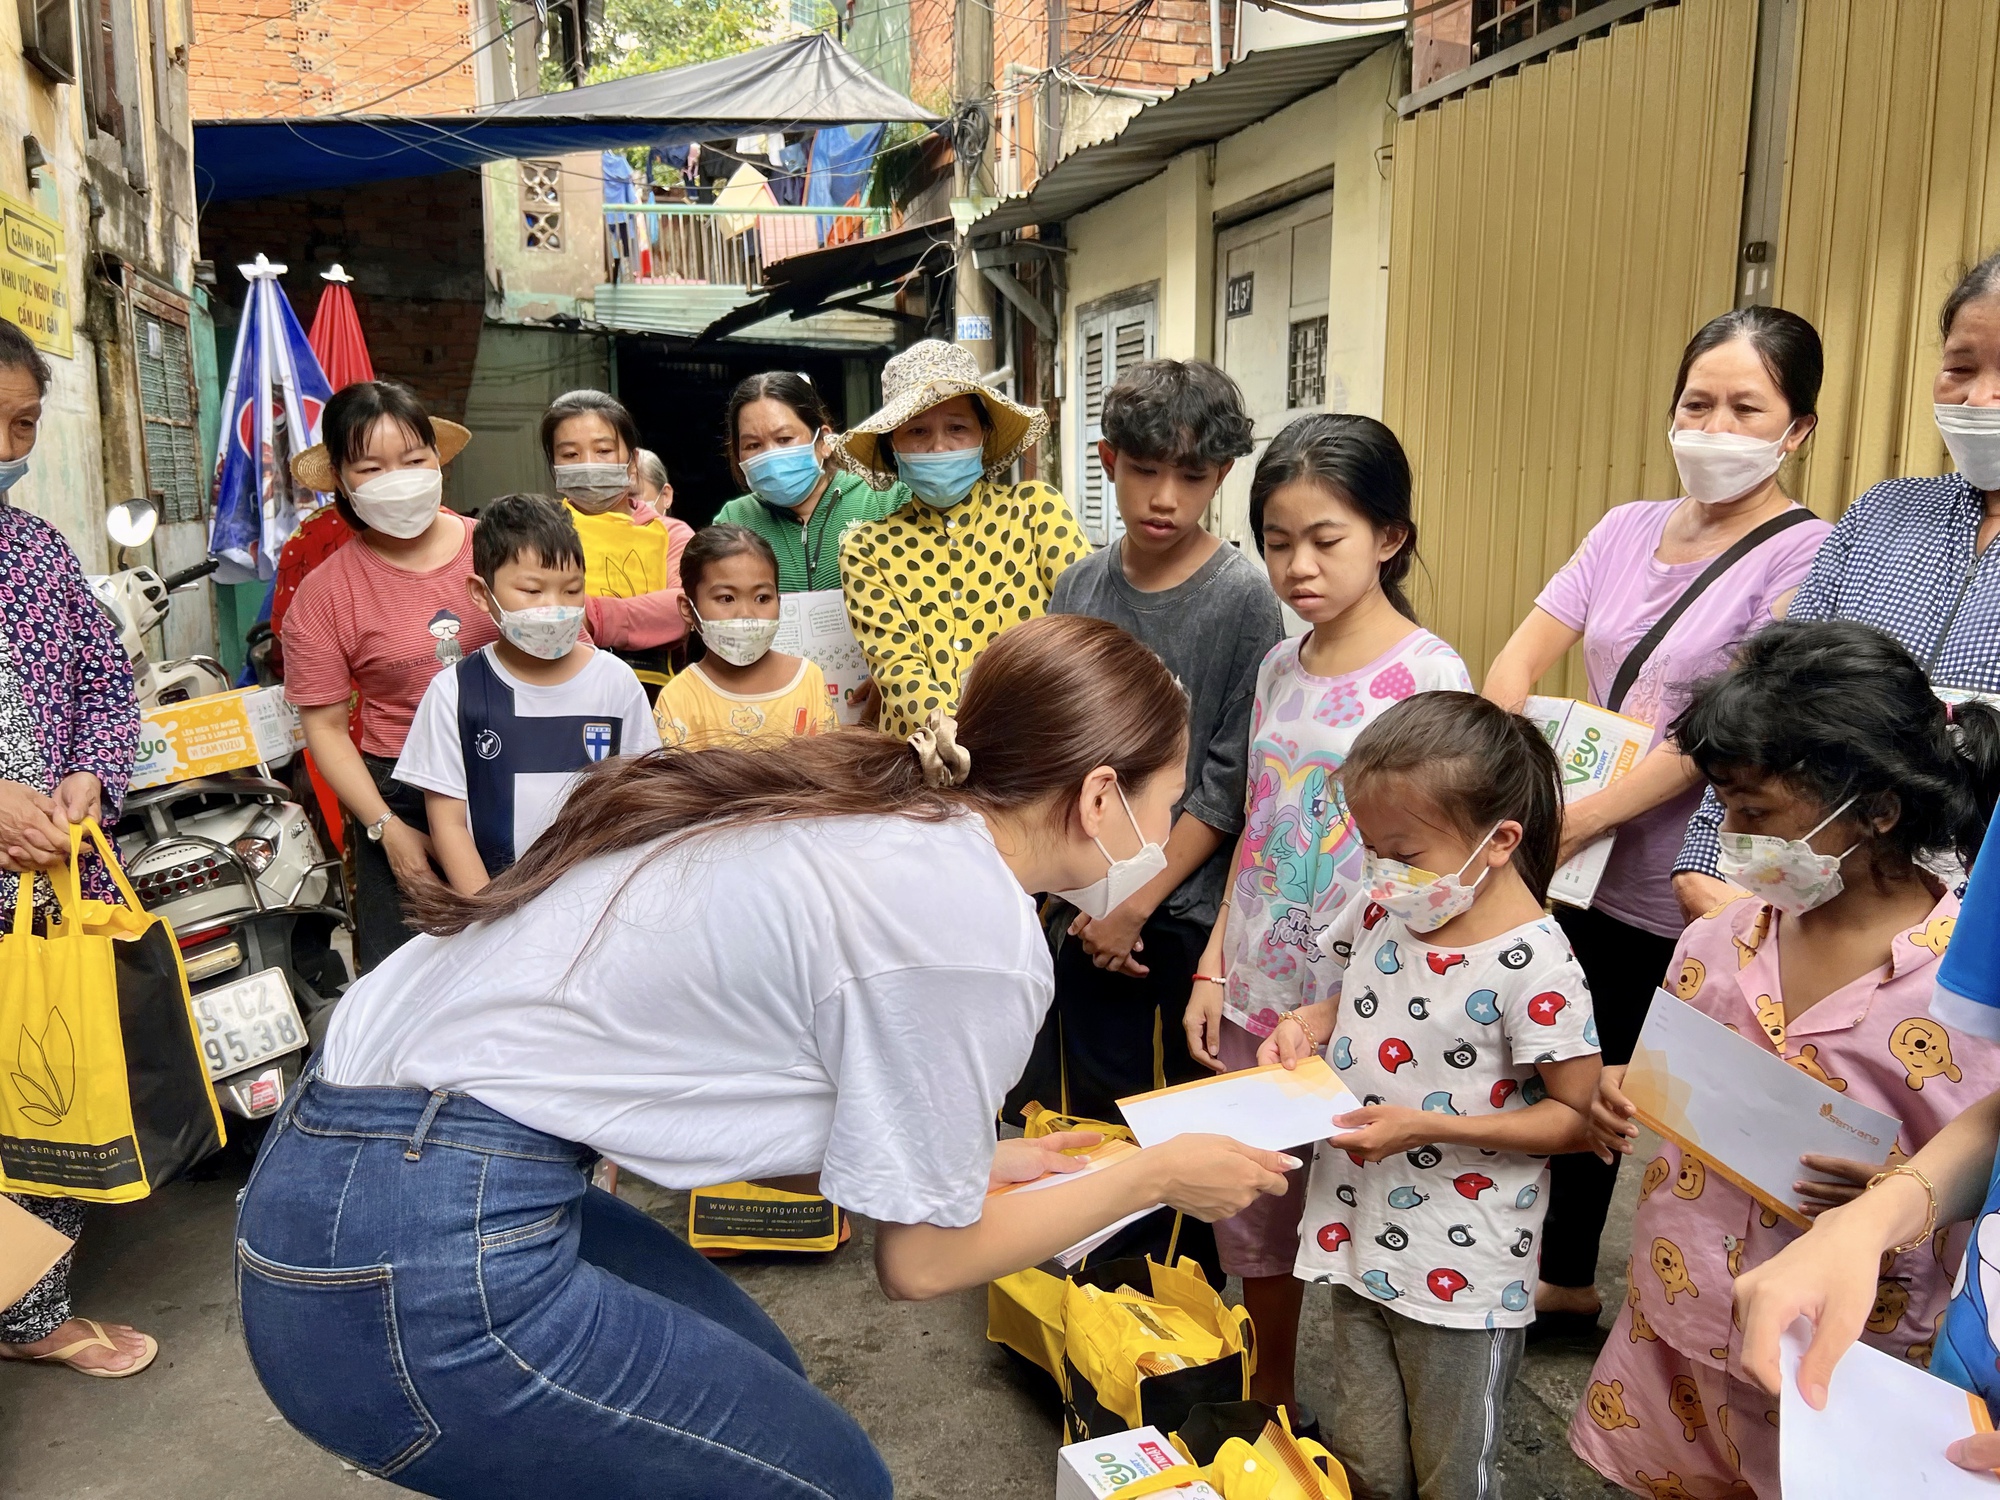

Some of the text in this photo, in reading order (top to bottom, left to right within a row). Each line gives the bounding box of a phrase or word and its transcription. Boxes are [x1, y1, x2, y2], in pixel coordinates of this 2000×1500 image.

[36, 238, 52, 263] BÁO
[1, 267, 16, 290] KHU
[33, 281, 50, 303] NGUY
[136, 740, 167, 763] yo
[201, 744, 219, 756] CAM
[219, 739, 241, 752] YUZU
[1562, 727, 1601, 786] Veyo
[1617, 744, 1635, 767] YUZU
[1592, 750, 1609, 780] YOGURT
[146, 846, 198, 864] HONDA
[1829, 1114, 1880, 1146] Senvang
[709, 1202, 823, 1216] www.senvangvn.com
